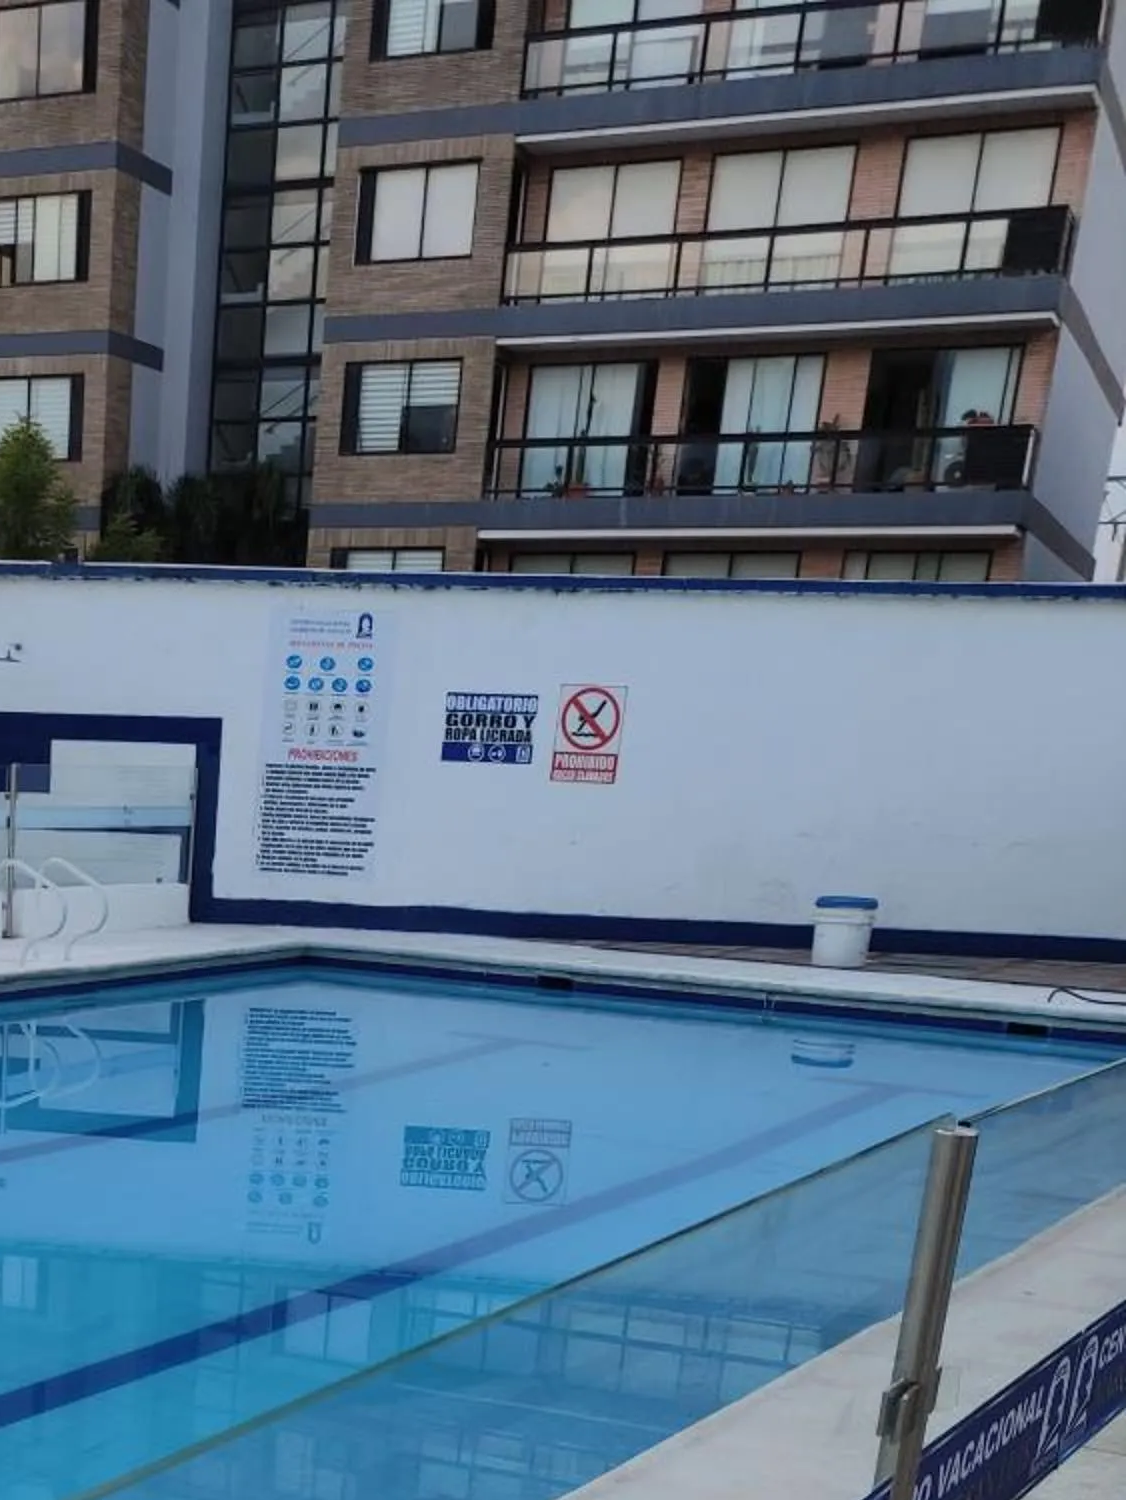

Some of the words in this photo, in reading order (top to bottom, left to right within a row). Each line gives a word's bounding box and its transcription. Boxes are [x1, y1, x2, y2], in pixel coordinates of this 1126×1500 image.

[447, 694, 538, 713] OBLIGATORIO
[446, 713, 517, 729] GORRO
[523, 715, 537, 729] Y
[445, 727, 477, 742] ROPA
[479, 729, 532, 743] LICRADA
[937, 1385, 1045, 1499] VACACIONAL
